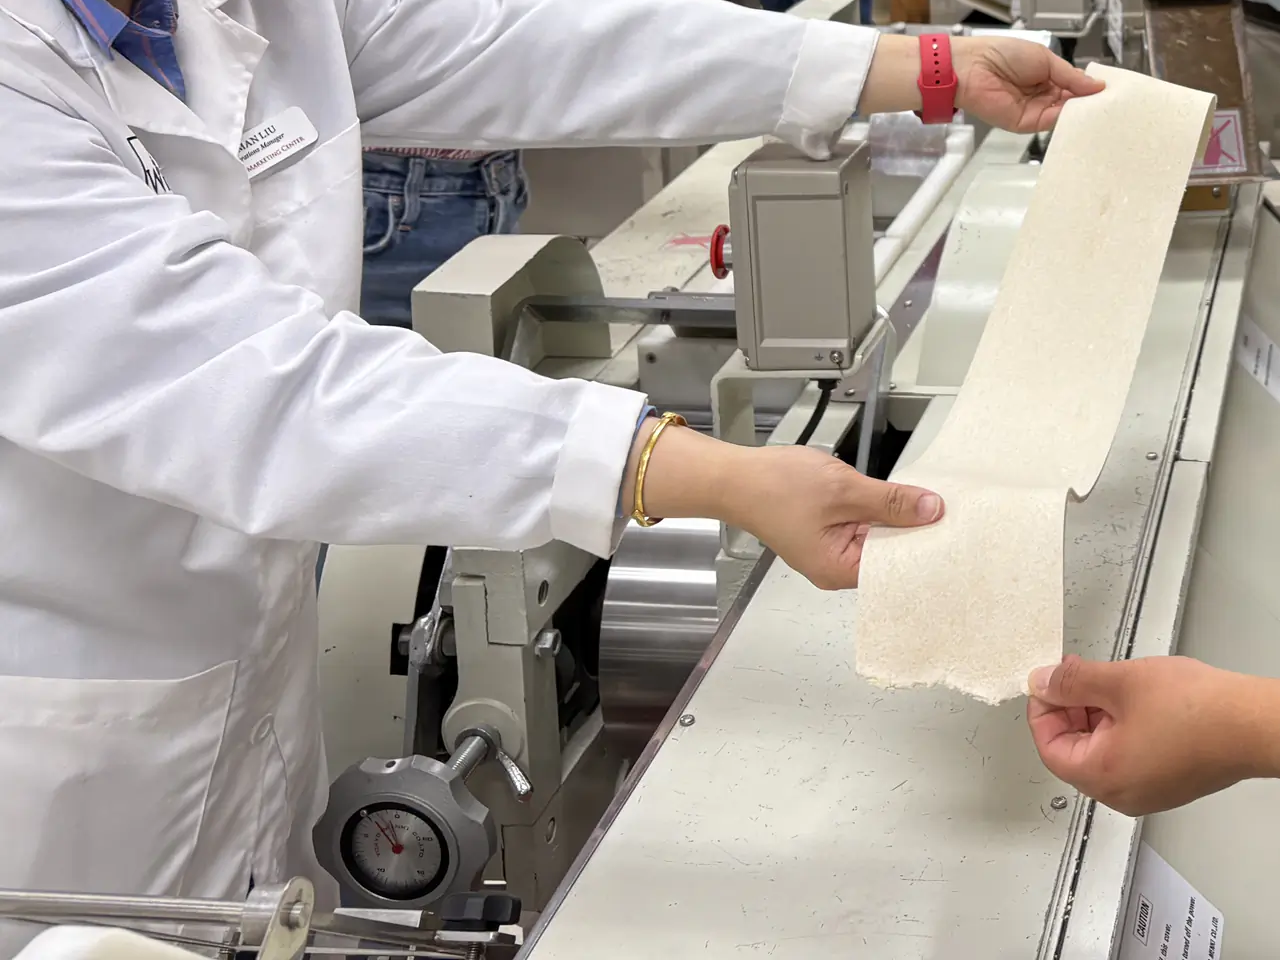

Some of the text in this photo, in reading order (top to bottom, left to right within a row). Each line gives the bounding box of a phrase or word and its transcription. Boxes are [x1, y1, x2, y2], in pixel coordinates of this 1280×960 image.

[258, 124, 277, 140] LIU
[260, 132, 285, 150] Manager
[280, 136, 305, 152] CENTER
[1136, 900, 1150, 938] CAUTION
[1182, 936, 1190, 960] turned
[1186, 915, 1194, 928] the
[1160, 942, 1169, 957] this
